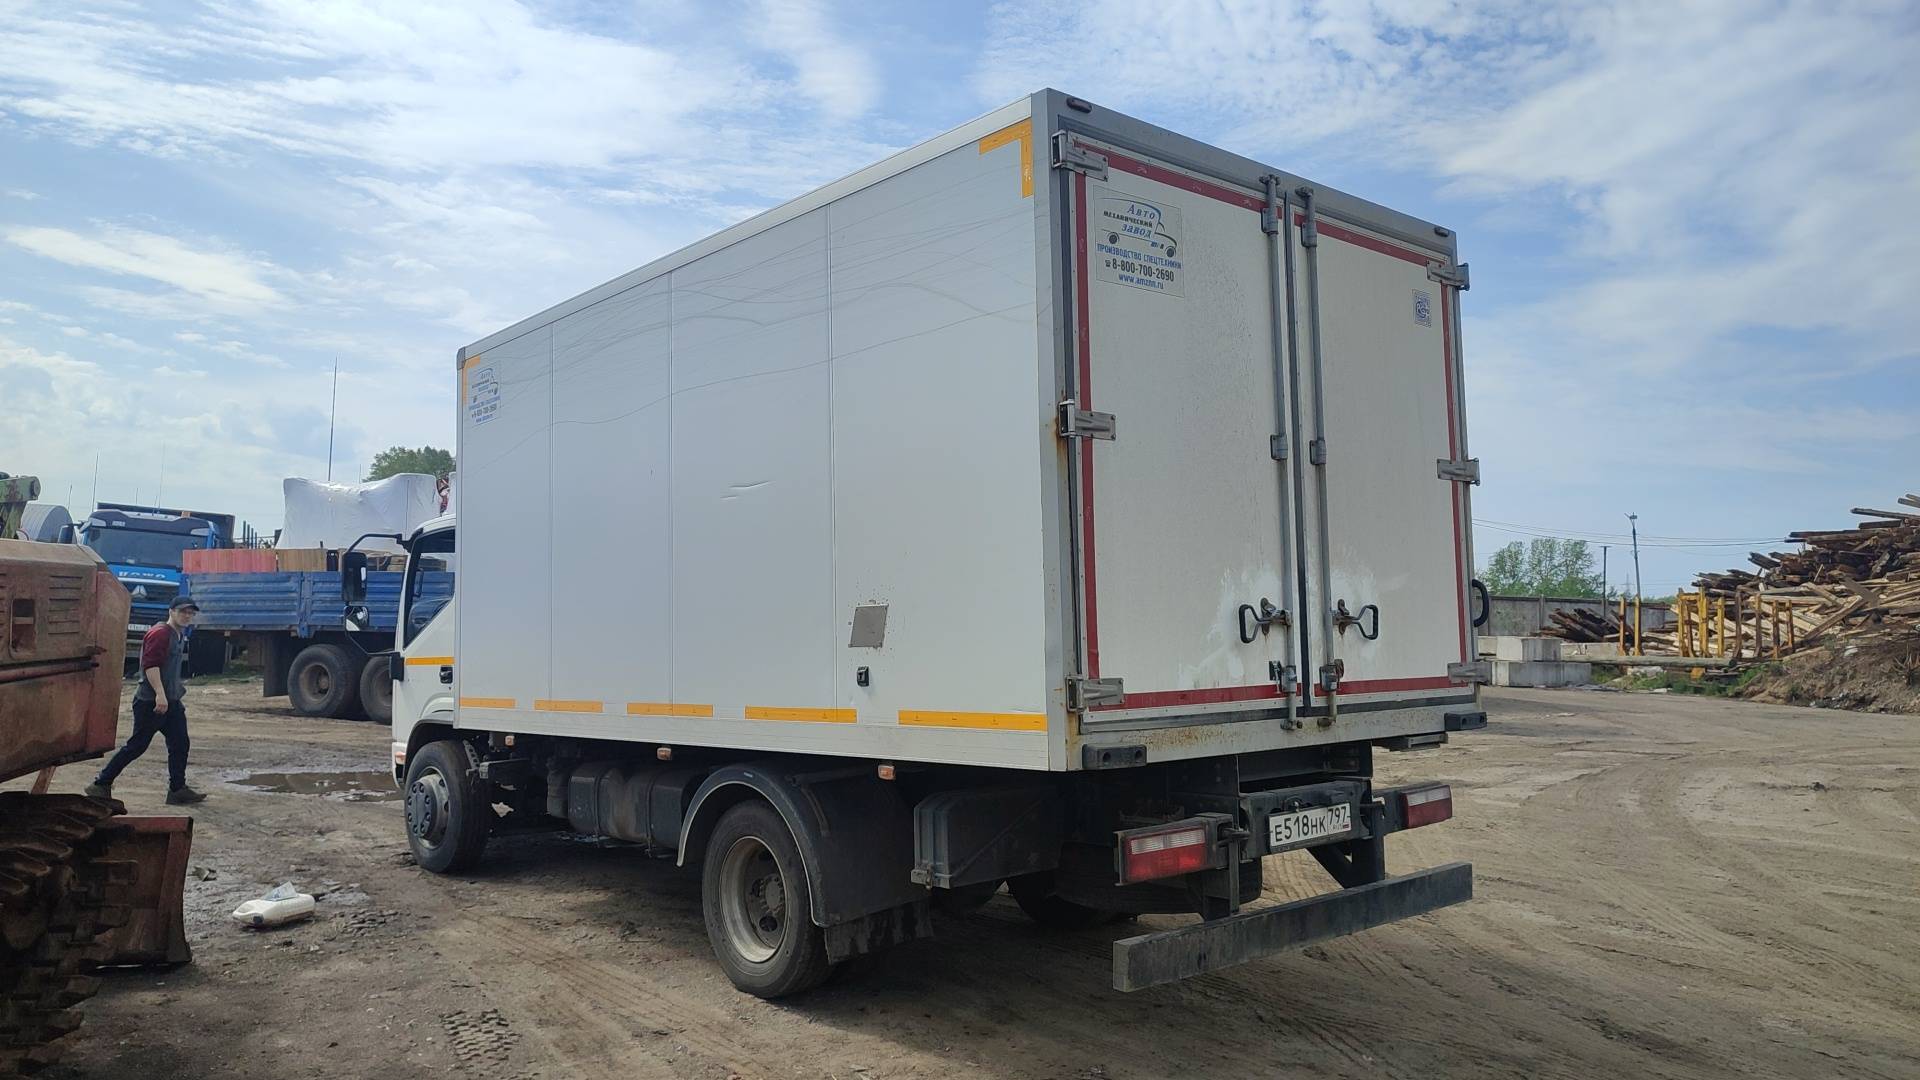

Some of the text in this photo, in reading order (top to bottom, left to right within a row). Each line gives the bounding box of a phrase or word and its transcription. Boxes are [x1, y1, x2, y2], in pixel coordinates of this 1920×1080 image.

[1097, 243, 1141, 261] ПРОИЗВОДСТВО
[1143, 254, 1182, 270] СПЕЦТЕХНИКИ
[1112, 258, 1175, 282] 8-800-700-2690
[1328, 806, 1347, 826] 797
